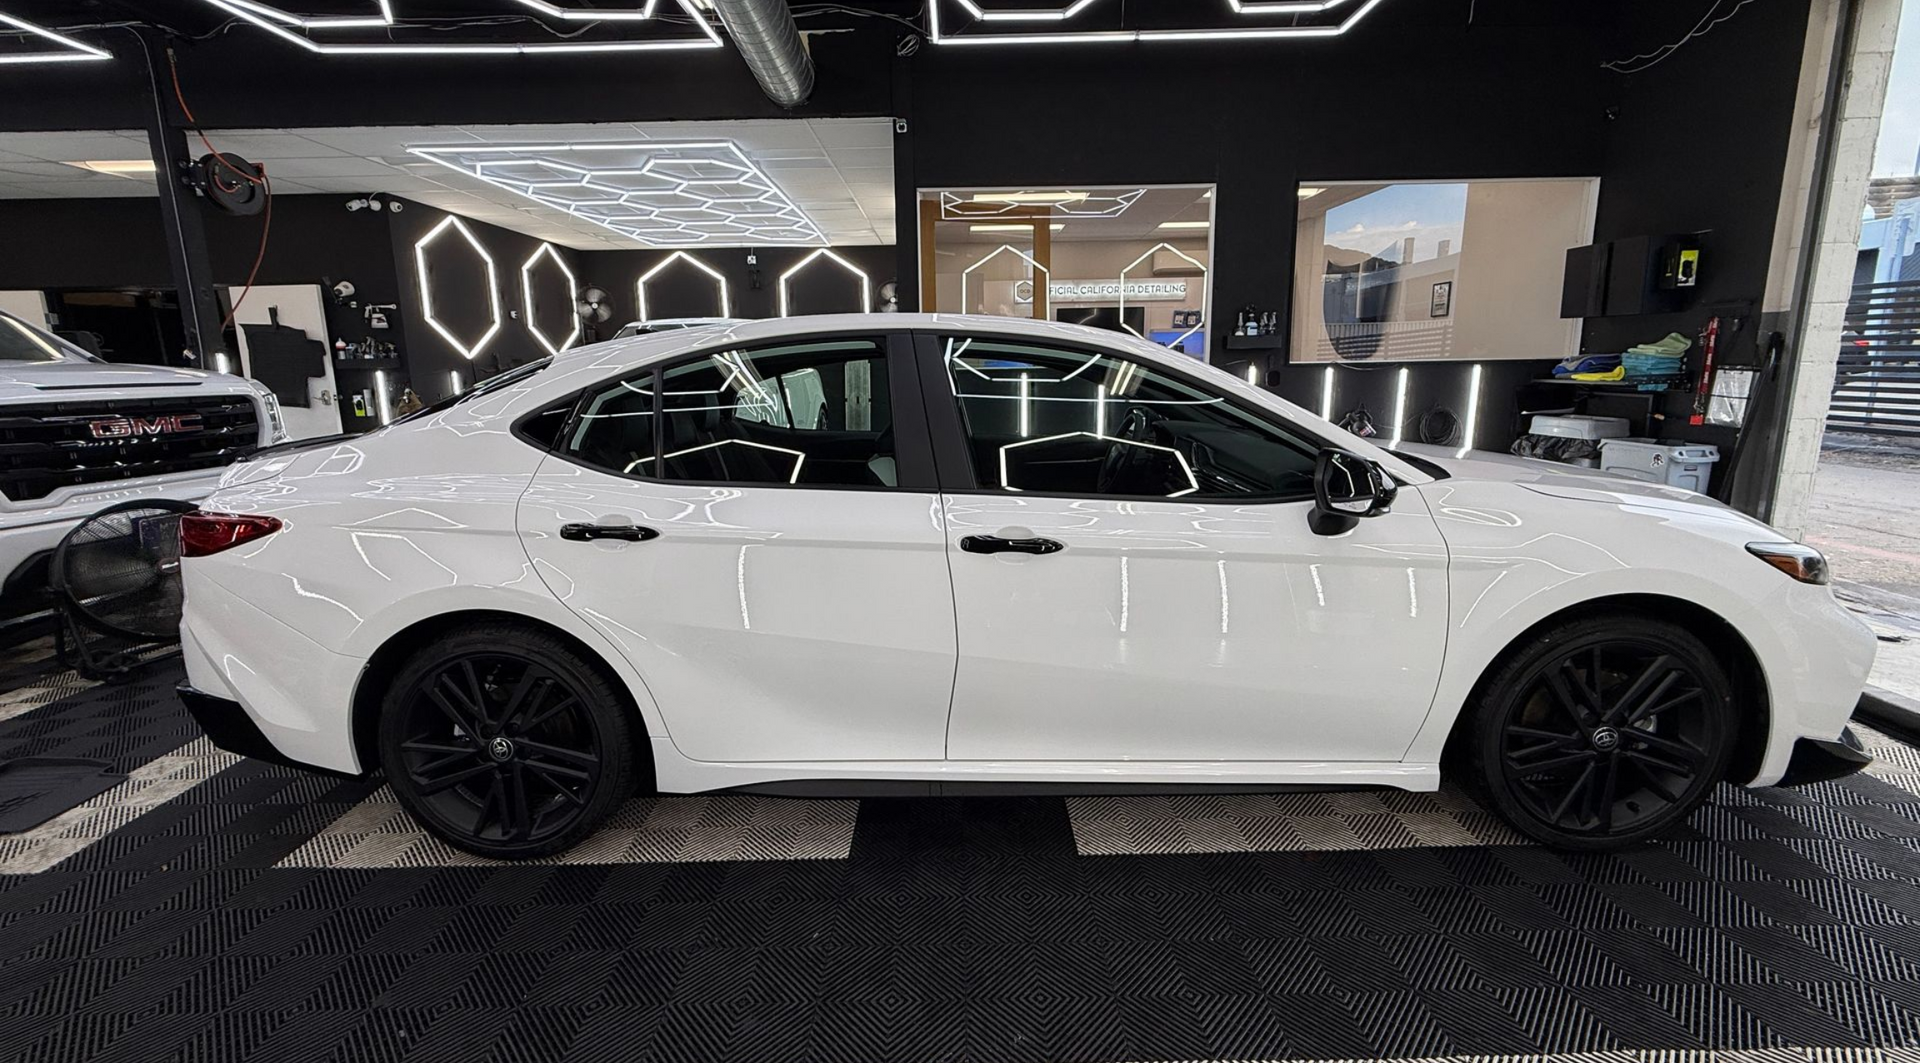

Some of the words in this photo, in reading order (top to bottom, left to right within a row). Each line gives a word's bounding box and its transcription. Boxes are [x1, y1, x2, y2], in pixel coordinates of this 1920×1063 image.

[1049, 286, 1078, 295] FICIAL
[1080, 285, 1135, 295] CALIFORNIA
[1137, 284, 1186, 294] DETAILING
[89, 414, 204, 438] GMC
